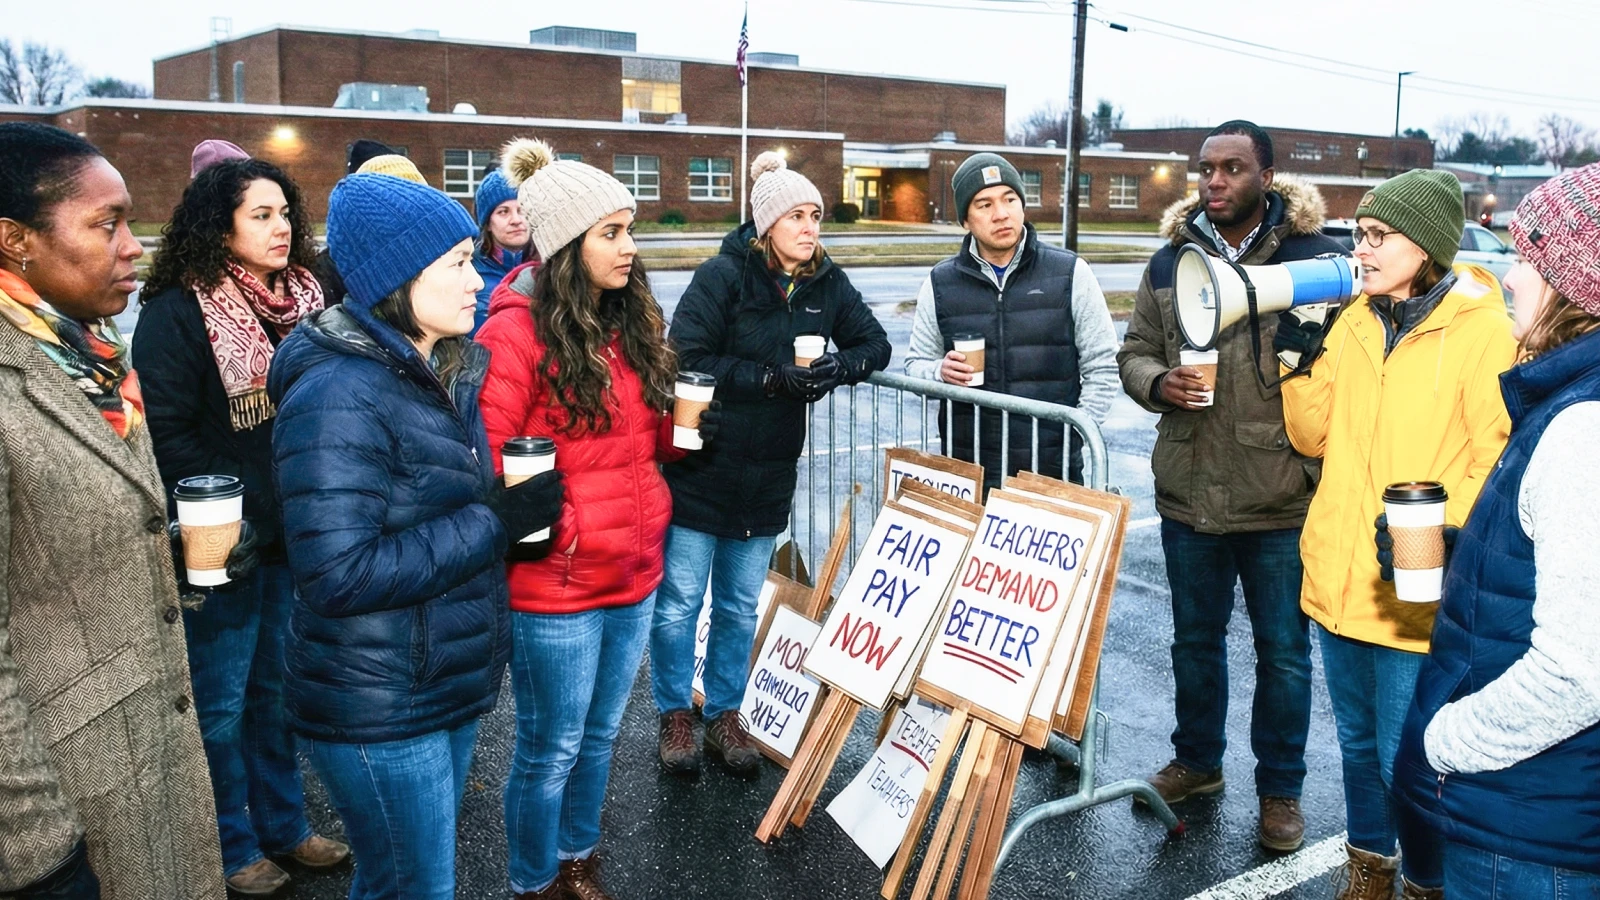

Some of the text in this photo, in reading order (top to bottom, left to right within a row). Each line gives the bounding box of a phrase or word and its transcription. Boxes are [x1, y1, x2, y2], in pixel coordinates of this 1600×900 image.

[877, 523, 941, 577] FAIR
[982, 514, 1084, 571] TEACHERS
[861, 569, 921, 619] PAY
[961, 556, 1059, 613] DEMAND
[829, 612, 903, 671] NOW
[944, 599, 1040, 668] BETTER
[750, 697, 791, 739] FAIR
